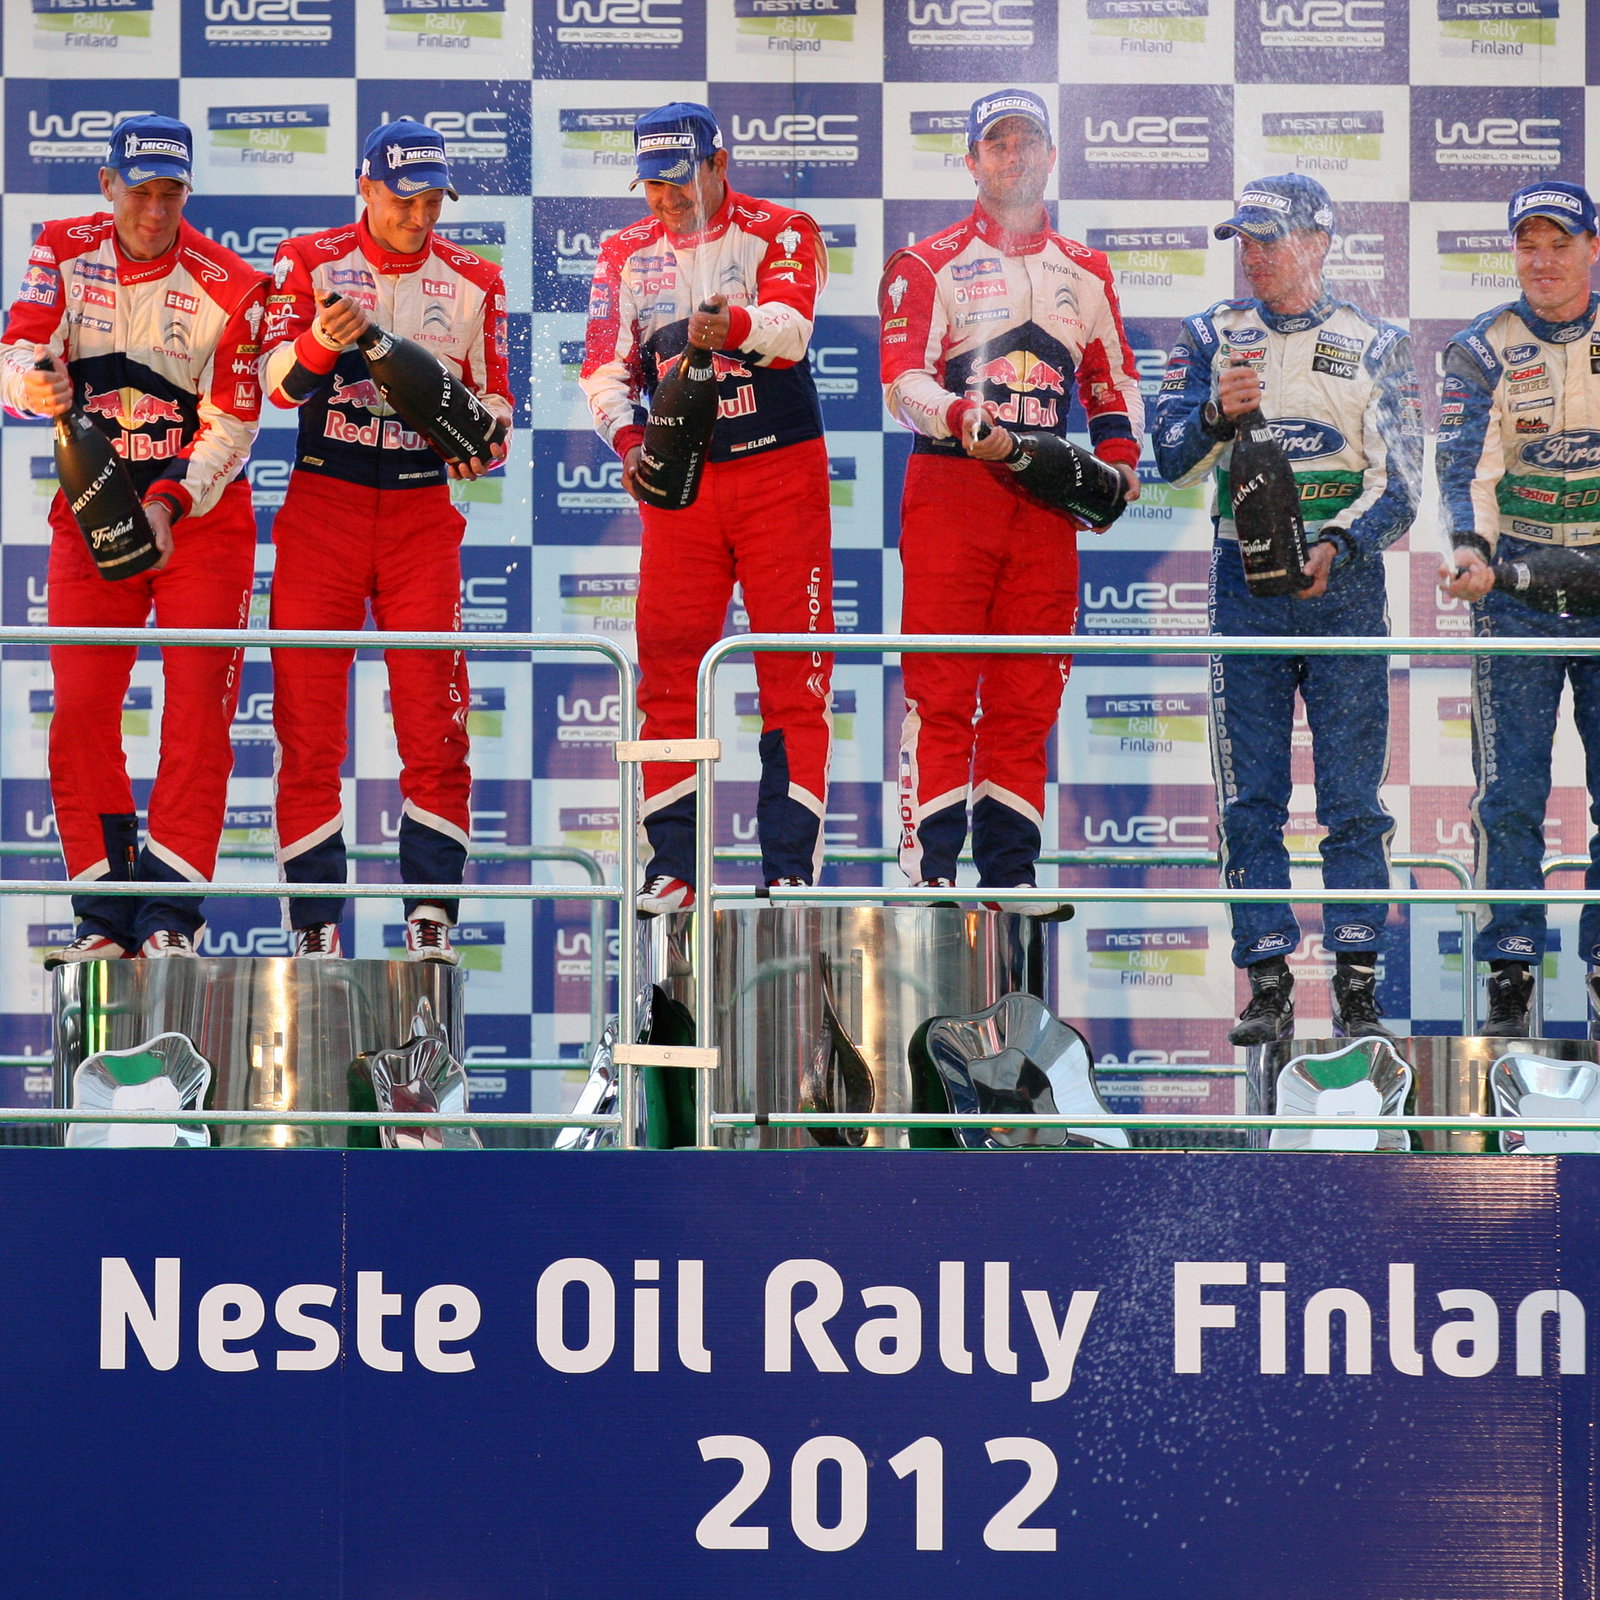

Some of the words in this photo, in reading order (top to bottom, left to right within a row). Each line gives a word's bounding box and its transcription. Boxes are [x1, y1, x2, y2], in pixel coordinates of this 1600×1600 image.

[1106, 0, 1163, 12] NESTE
[1166, 0, 1190, 11] OIL
[1458, 2, 1514, 14] NESTE
[1518, 2, 1542, 13] OIL
[73, 12, 114, 32] Rally
[424, 14, 466, 33] Rally
[776, 16, 817, 36] Rally
[1128, 19, 1169, 38] Rally
[1480, 20, 1520, 39] Rally
[66, 33, 116, 48] Finland
[417, 34, 468, 50] Finland
[768, 37, 820, 52] Finland
[1120, 40, 1172, 54] Finland
[1472, 40, 1523, 56] Finland
[226, 112, 284, 124] NESTE
[286, 112, 310, 123] OIL
[425, 112, 506, 138] RC
[930, 117, 967, 128] NES
[1281, 118, 1338, 130] NESTE
[1341, 118, 1365, 130] OIL
[248, 130, 290, 148] Rally
[601, 131, 635, 149] Rall
[640, 135, 691, 148] MICHELIN
[1303, 136, 1344, 156] Rally
[241, 150, 292, 165] Finland
[406, 149, 445, 161] MICHEL
[1296, 157, 1346, 172] Finland
[1524, 192, 1579, 209] MICHELIN
[1106, 234, 1163, 246] NESTE
[1166, 234, 1190, 245] OIL
[1128, 252, 1169, 271] Rally
[1120, 272, 1172, 288] Finland
[29, 287, 55, 304] Bull
[86, 289, 114, 305] TTAL
[1229, 330, 1257, 342] Ford
[153, 346, 194, 364] CITRO
[1470, 336, 1496, 369] sparco
[1508, 348, 1532, 362] Ford
[716, 384, 758, 420] ull
[1024, 396, 1059, 428] Bull
[324, 410, 380, 446] Red
[436, 415, 478, 456] FREIXENET
[131, 428, 182, 462] Bull
[748, 434, 777, 450] ELENA
[1537, 434, 1600, 464] For
[558, 462, 623, 488] WR
[680, 452, 698, 505] FREIXENET
[72, 458, 117, 515] FREIXENET
[1140, 485, 1169, 504] ally
[1297, 483, 1360, 500] DGE
[1517, 486, 1556, 504] Castrol
[1563, 488, 1600, 509] ED
[1124, 505, 1172, 519] inland
[578, 580, 636, 590] NESTE
[1208, 546, 1222, 606] Powered
[1084, 582, 1209, 609] WRC
[593, 617, 635, 630] Finlan
[806, 566, 822, 668] CROËN
[557, 695, 620, 722] WR
[1106, 700, 1163, 712] NESTE
[1166, 700, 1190, 710] OIL
[1128, 718, 1169, 737] Rally
[1478, 676, 1498, 784] EcoBoost
[1120, 738, 1172, 754] Finland
[1214, 697, 1239, 804] EcoBoost
[226, 811, 272, 824] NEST
[578, 813, 619, 825] NEST
[900, 794, 916, 850] LOEB
[1084, 816, 1209, 842] WRC
[205, 928, 289, 955] WR
[1106, 934, 1163, 946] NESTE
[1166, 934, 1190, 945] OIL
[1257, 934, 1286, 950] Ford
[1338, 926, 1368, 940] Ford
[1506, 938, 1534, 952] Ford
[1128, 951, 1169, 970] Rally
[1120, 972, 1172, 986] Finland
[98, 1256, 480, 1374] Neste
[535, 1258, 712, 1374] Oil
[764, 1260, 1099, 1402] Rally
[1173, 1262, 1587, 1377] Finlan
[695, 1435, 1058, 1553] 2012
